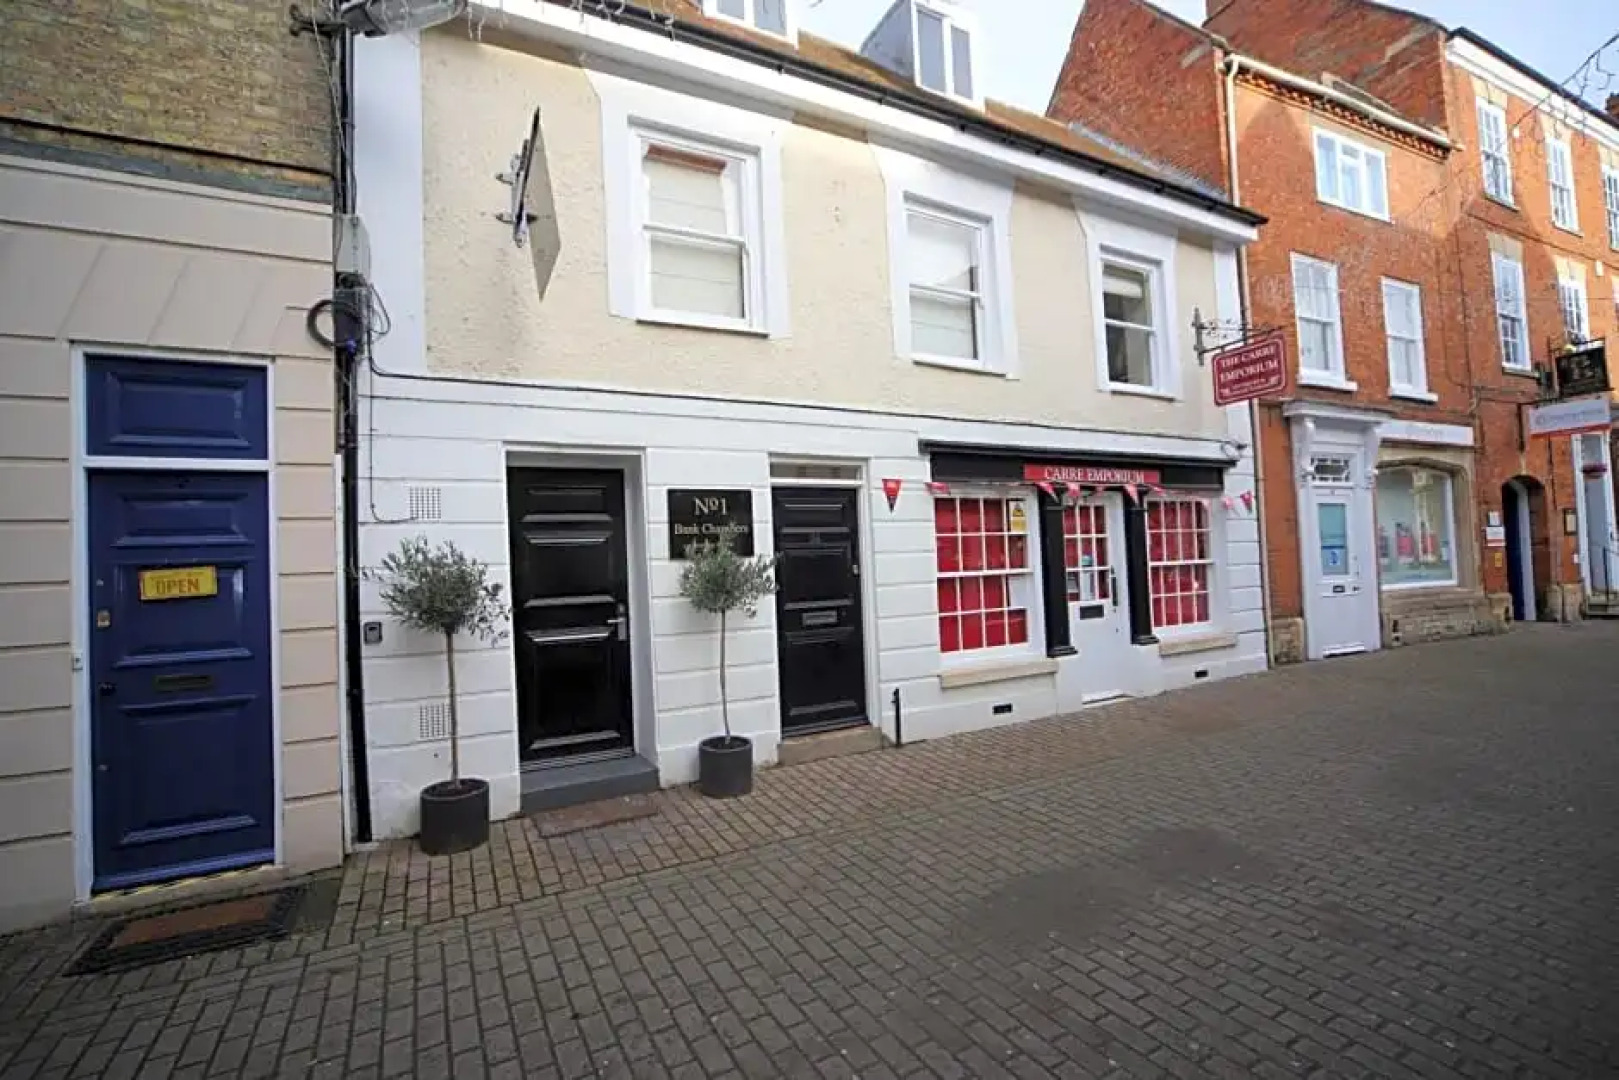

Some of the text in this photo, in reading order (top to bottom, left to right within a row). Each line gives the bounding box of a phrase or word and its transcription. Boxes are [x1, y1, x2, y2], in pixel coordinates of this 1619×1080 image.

[1219, 359, 1279, 383] EMPORIUM
[1221, 356, 1239, 370] THE
[1043, 465, 1145, 484] CARRE EMPORIUM
[156, 577, 200, 596] OPEN
